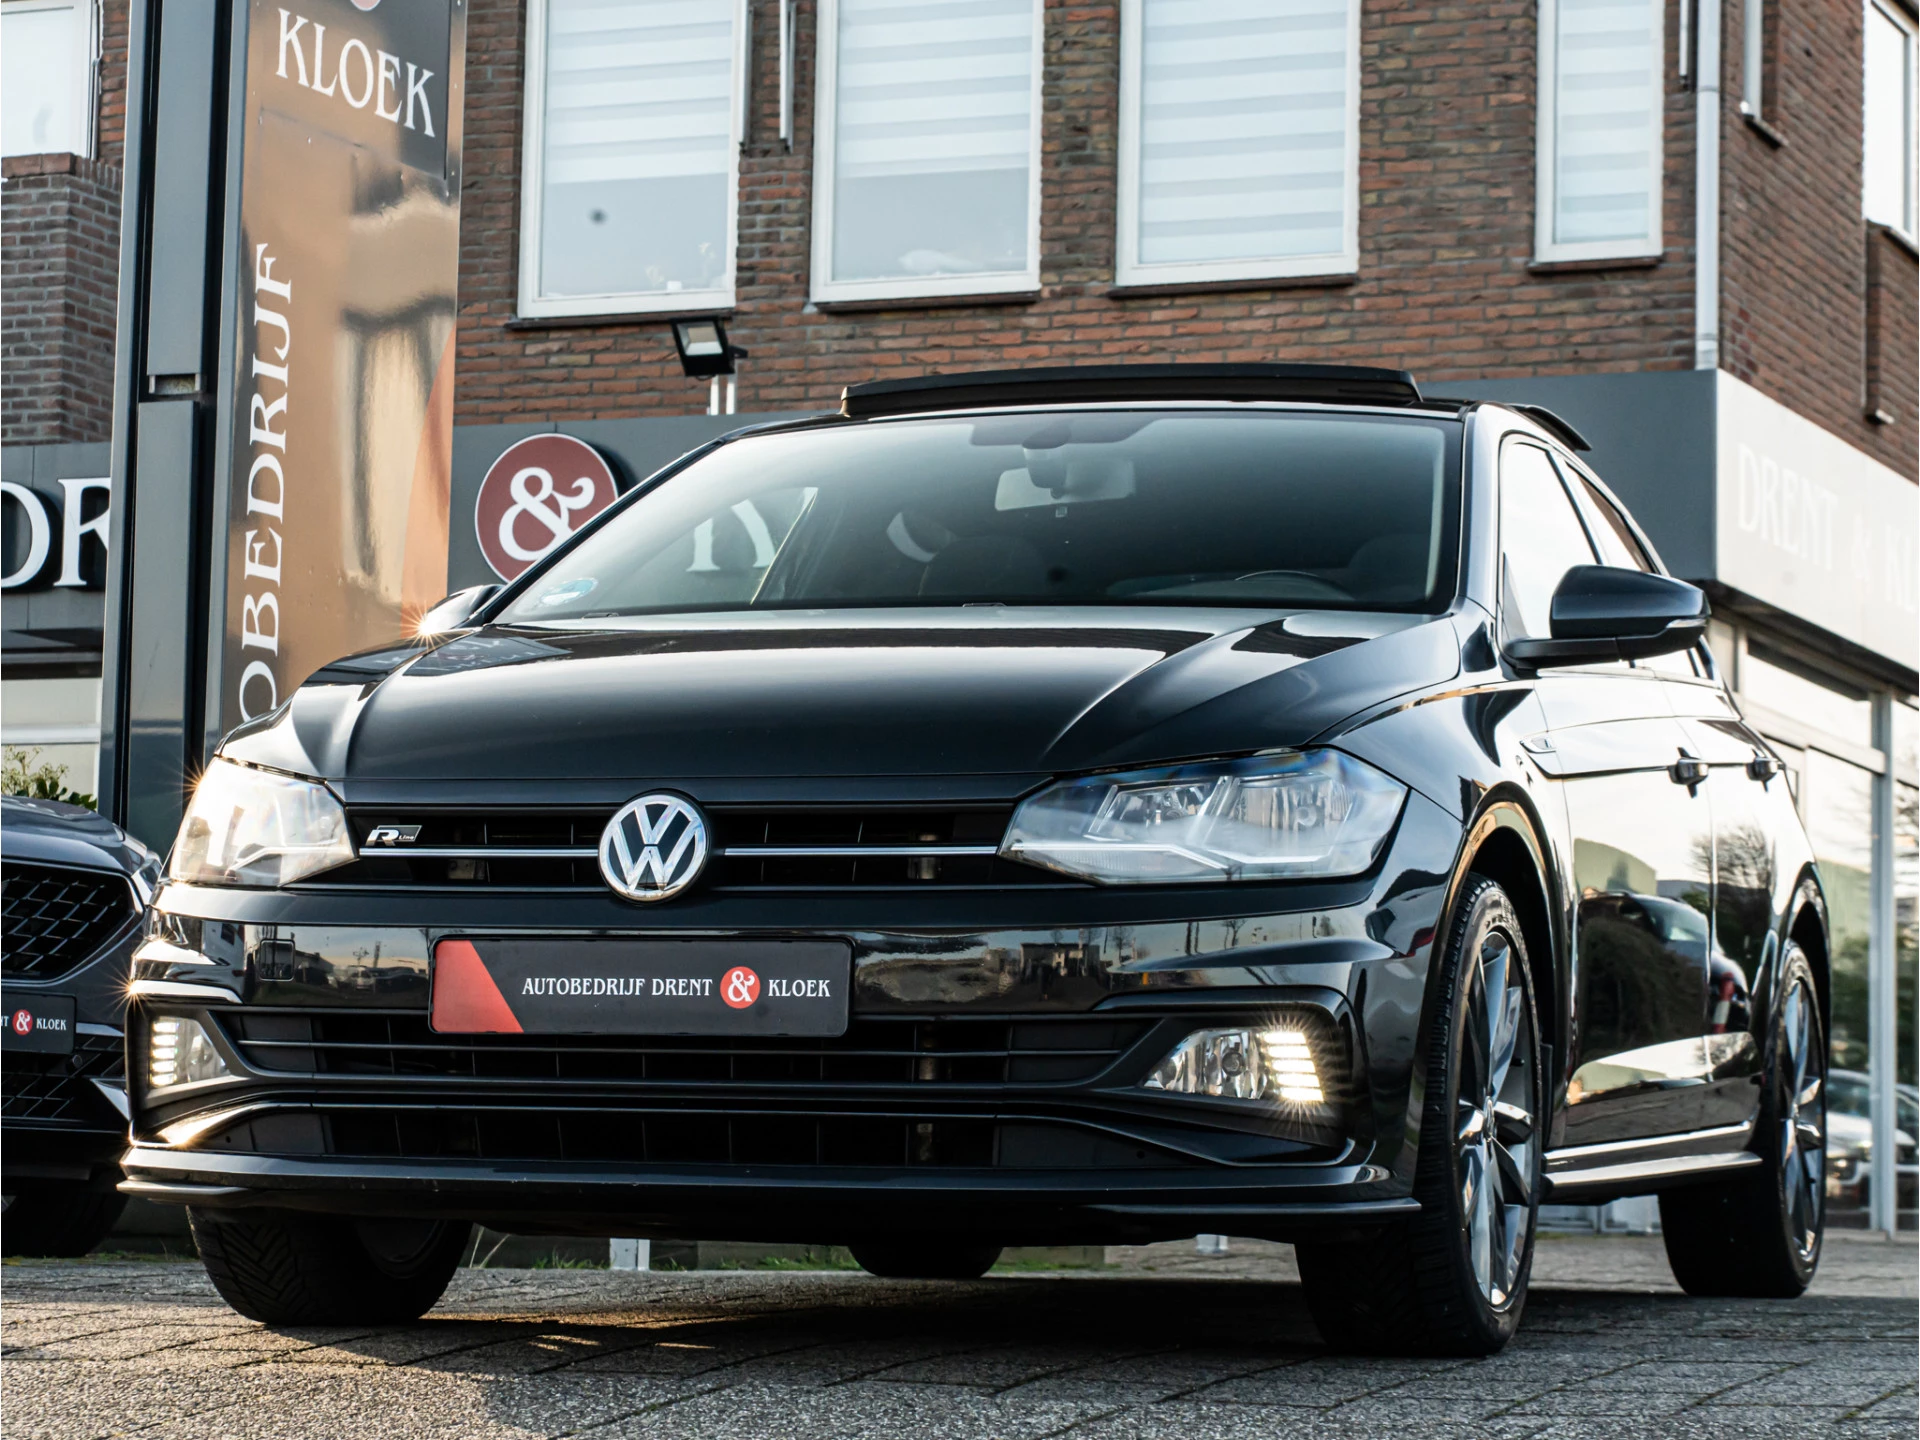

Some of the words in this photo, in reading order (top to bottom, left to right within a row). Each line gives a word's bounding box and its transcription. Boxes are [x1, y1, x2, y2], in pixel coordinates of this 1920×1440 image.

[276, 8, 436, 137] KLOEK
[1737, 442, 1840, 572] DRENT
[16, 1012, 31, 1032] &
[36, 1017, 67, 1031] KLOEK
[521, 977, 646, 996] AUTOBEDRIJF
[651, 978, 713, 997] DRENT
[727, 971, 755, 1002] &
[768, 979, 831, 998] KLOEK
